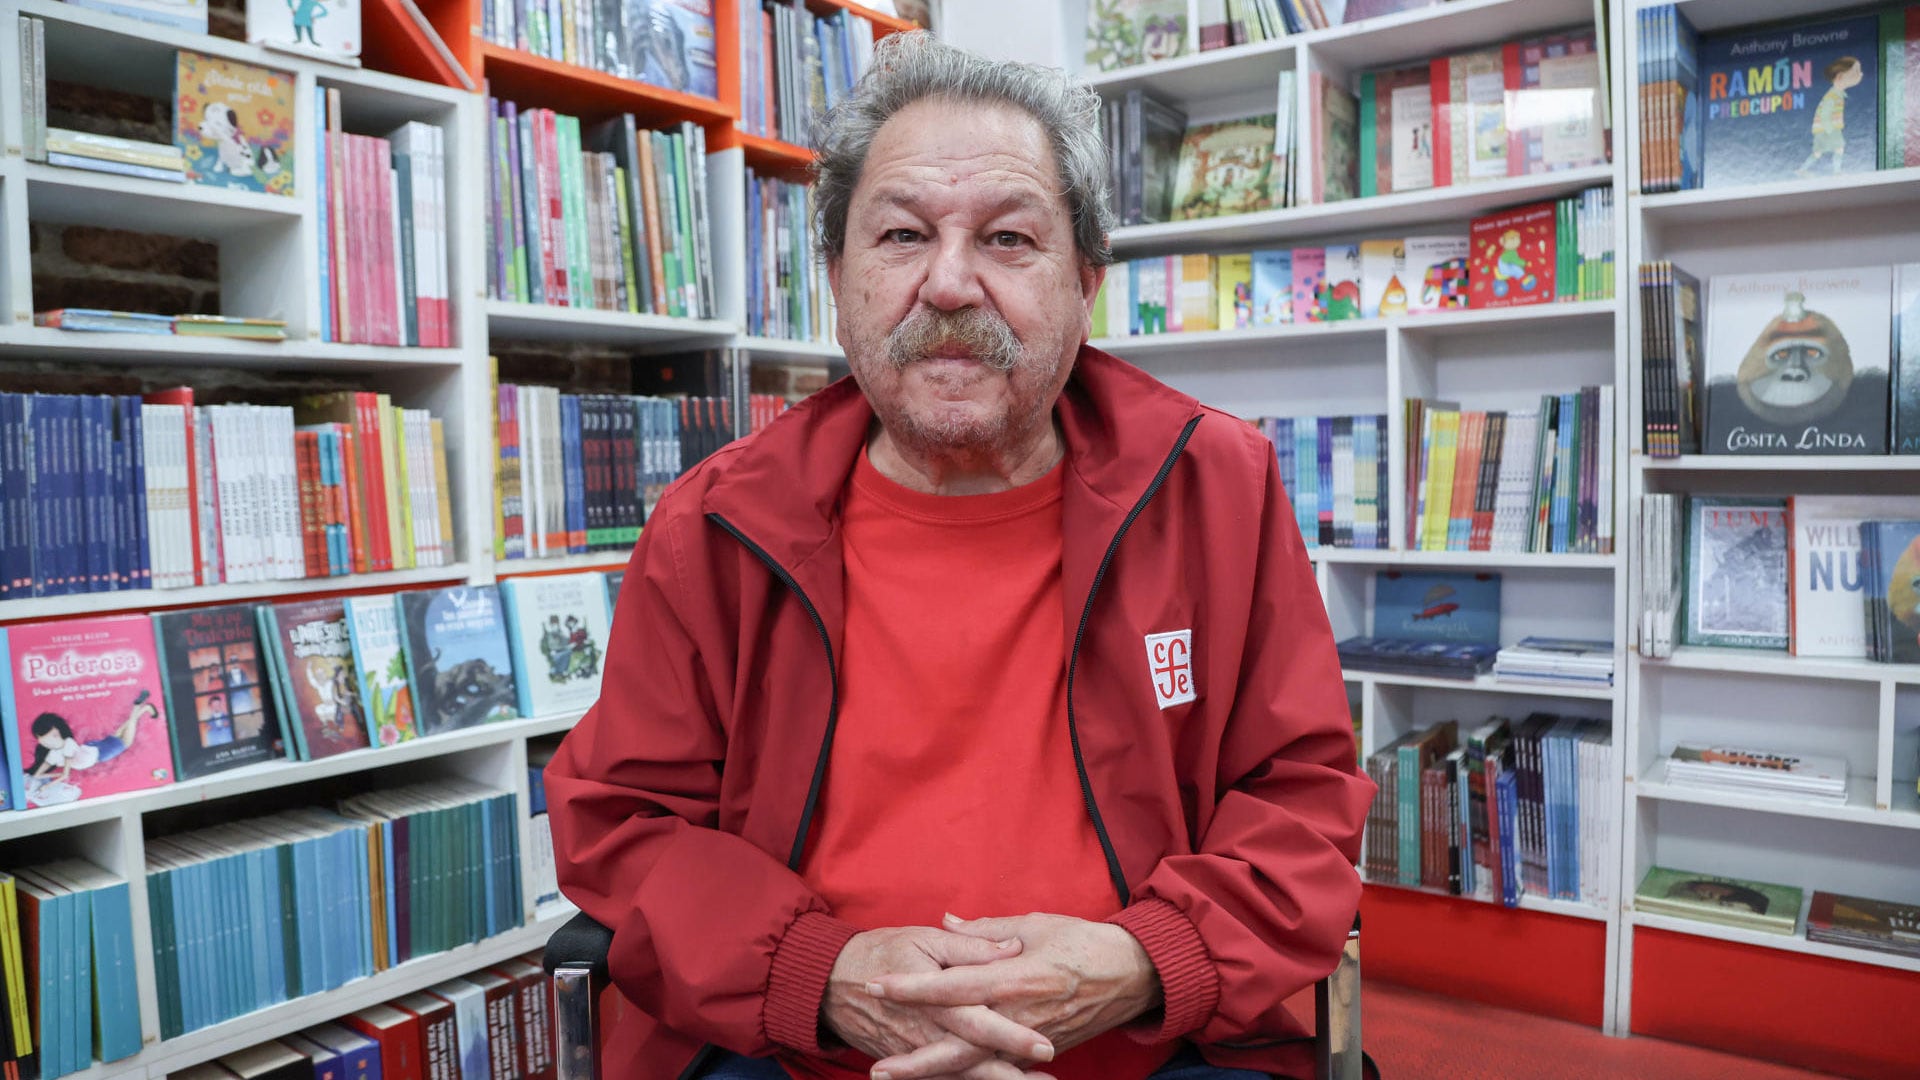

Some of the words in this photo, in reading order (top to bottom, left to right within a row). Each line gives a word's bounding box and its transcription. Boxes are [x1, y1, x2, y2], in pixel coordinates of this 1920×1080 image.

[1730, 41, 1787, 56] Anthony
[1792, 30, 1849, 48] Browne
[1709, 57, 1812, 100] RAMÓN
[1709, 91, 1805, 119] PREOCUPÓN
[1728, 280, 1791, 296] Anthony
[1798, 276, 1861, 292] Browne
[28, 654, 137, 679] Poderosa
